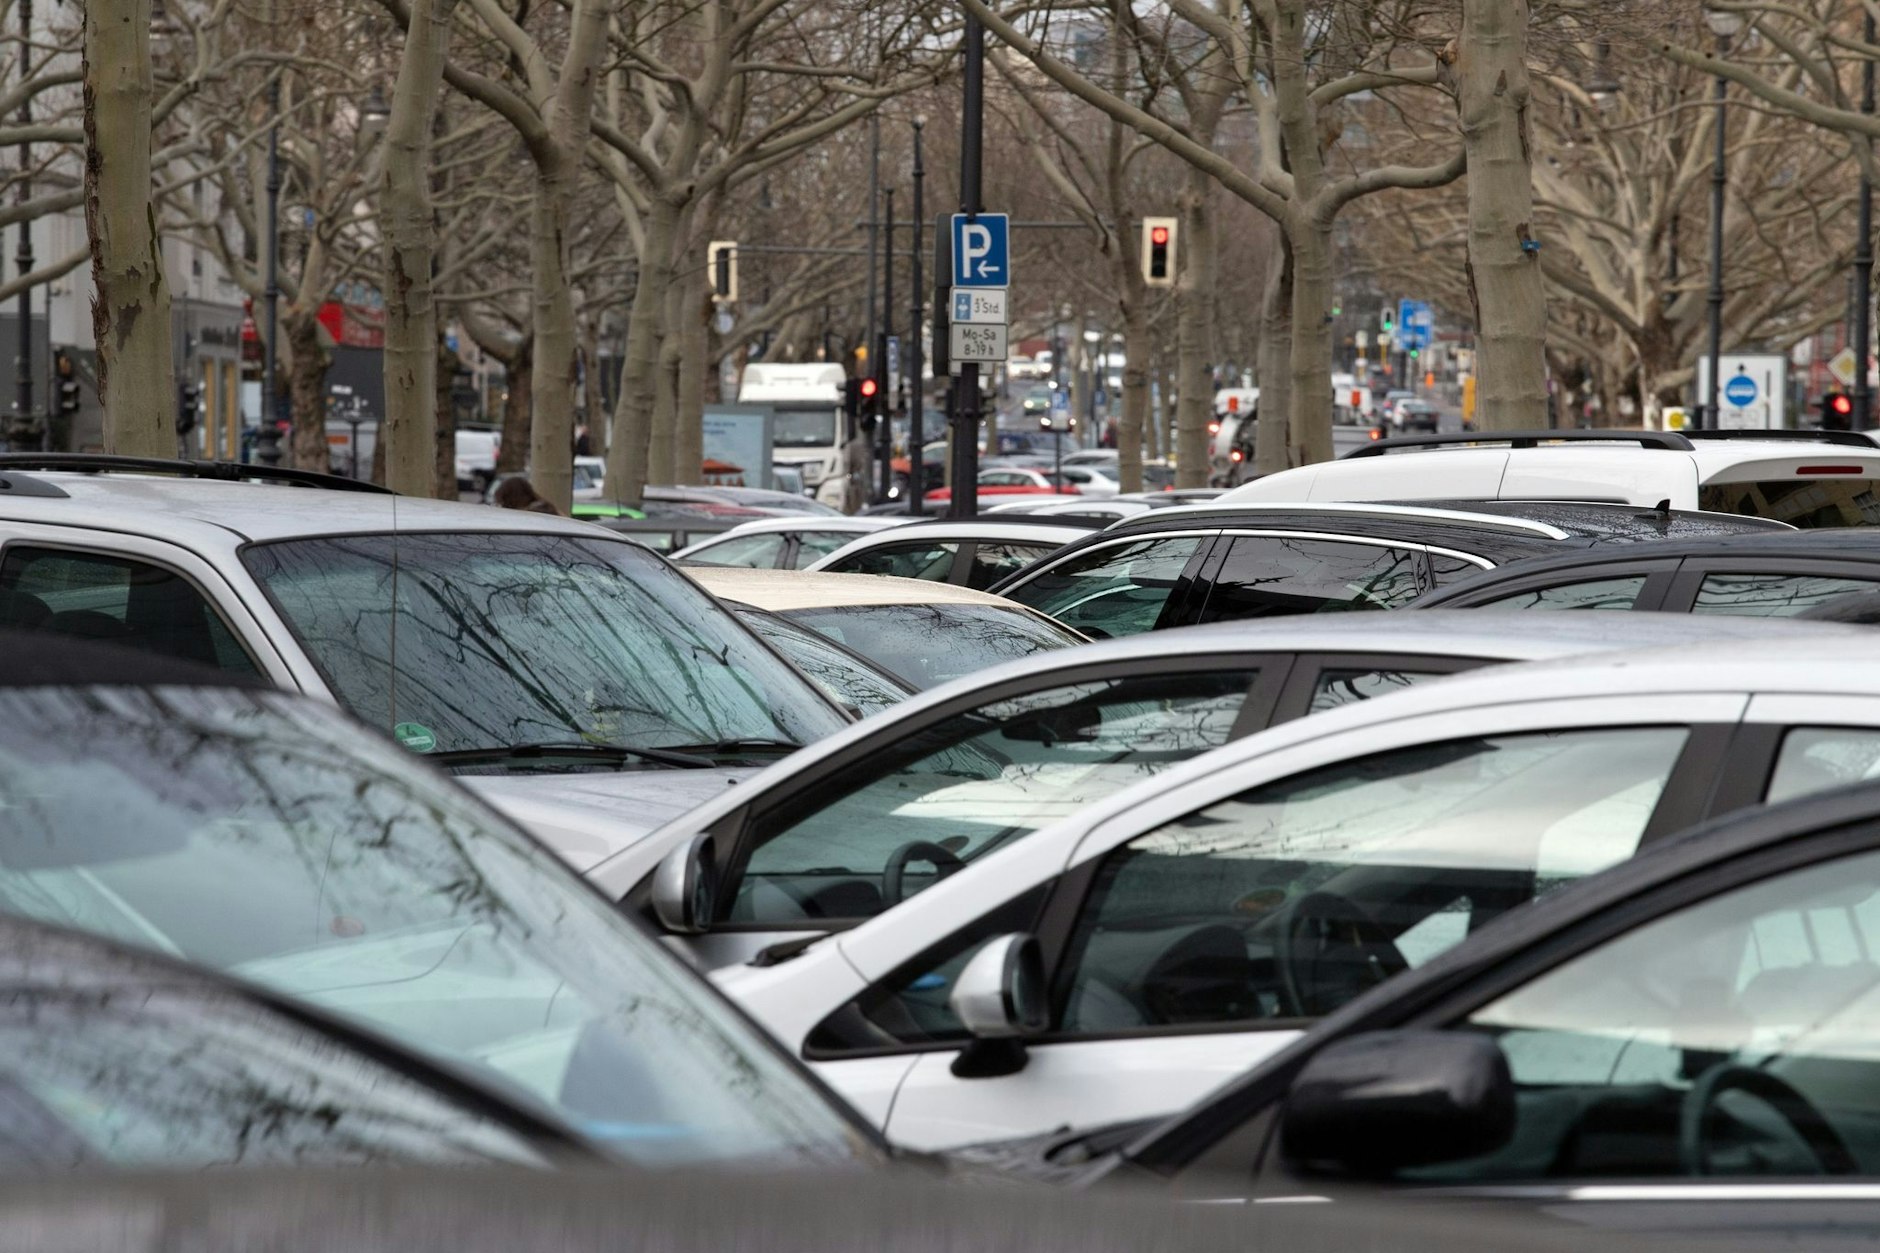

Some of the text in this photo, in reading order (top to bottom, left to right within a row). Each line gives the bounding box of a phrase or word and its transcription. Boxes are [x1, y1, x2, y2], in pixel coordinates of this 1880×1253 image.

[962, 224, 991, 278] P
[974, 302, 1002, 314] 3 Std.
[962, 328, 996, 340] Mo-Sa
[964, 344, 986, 355] 8-19
